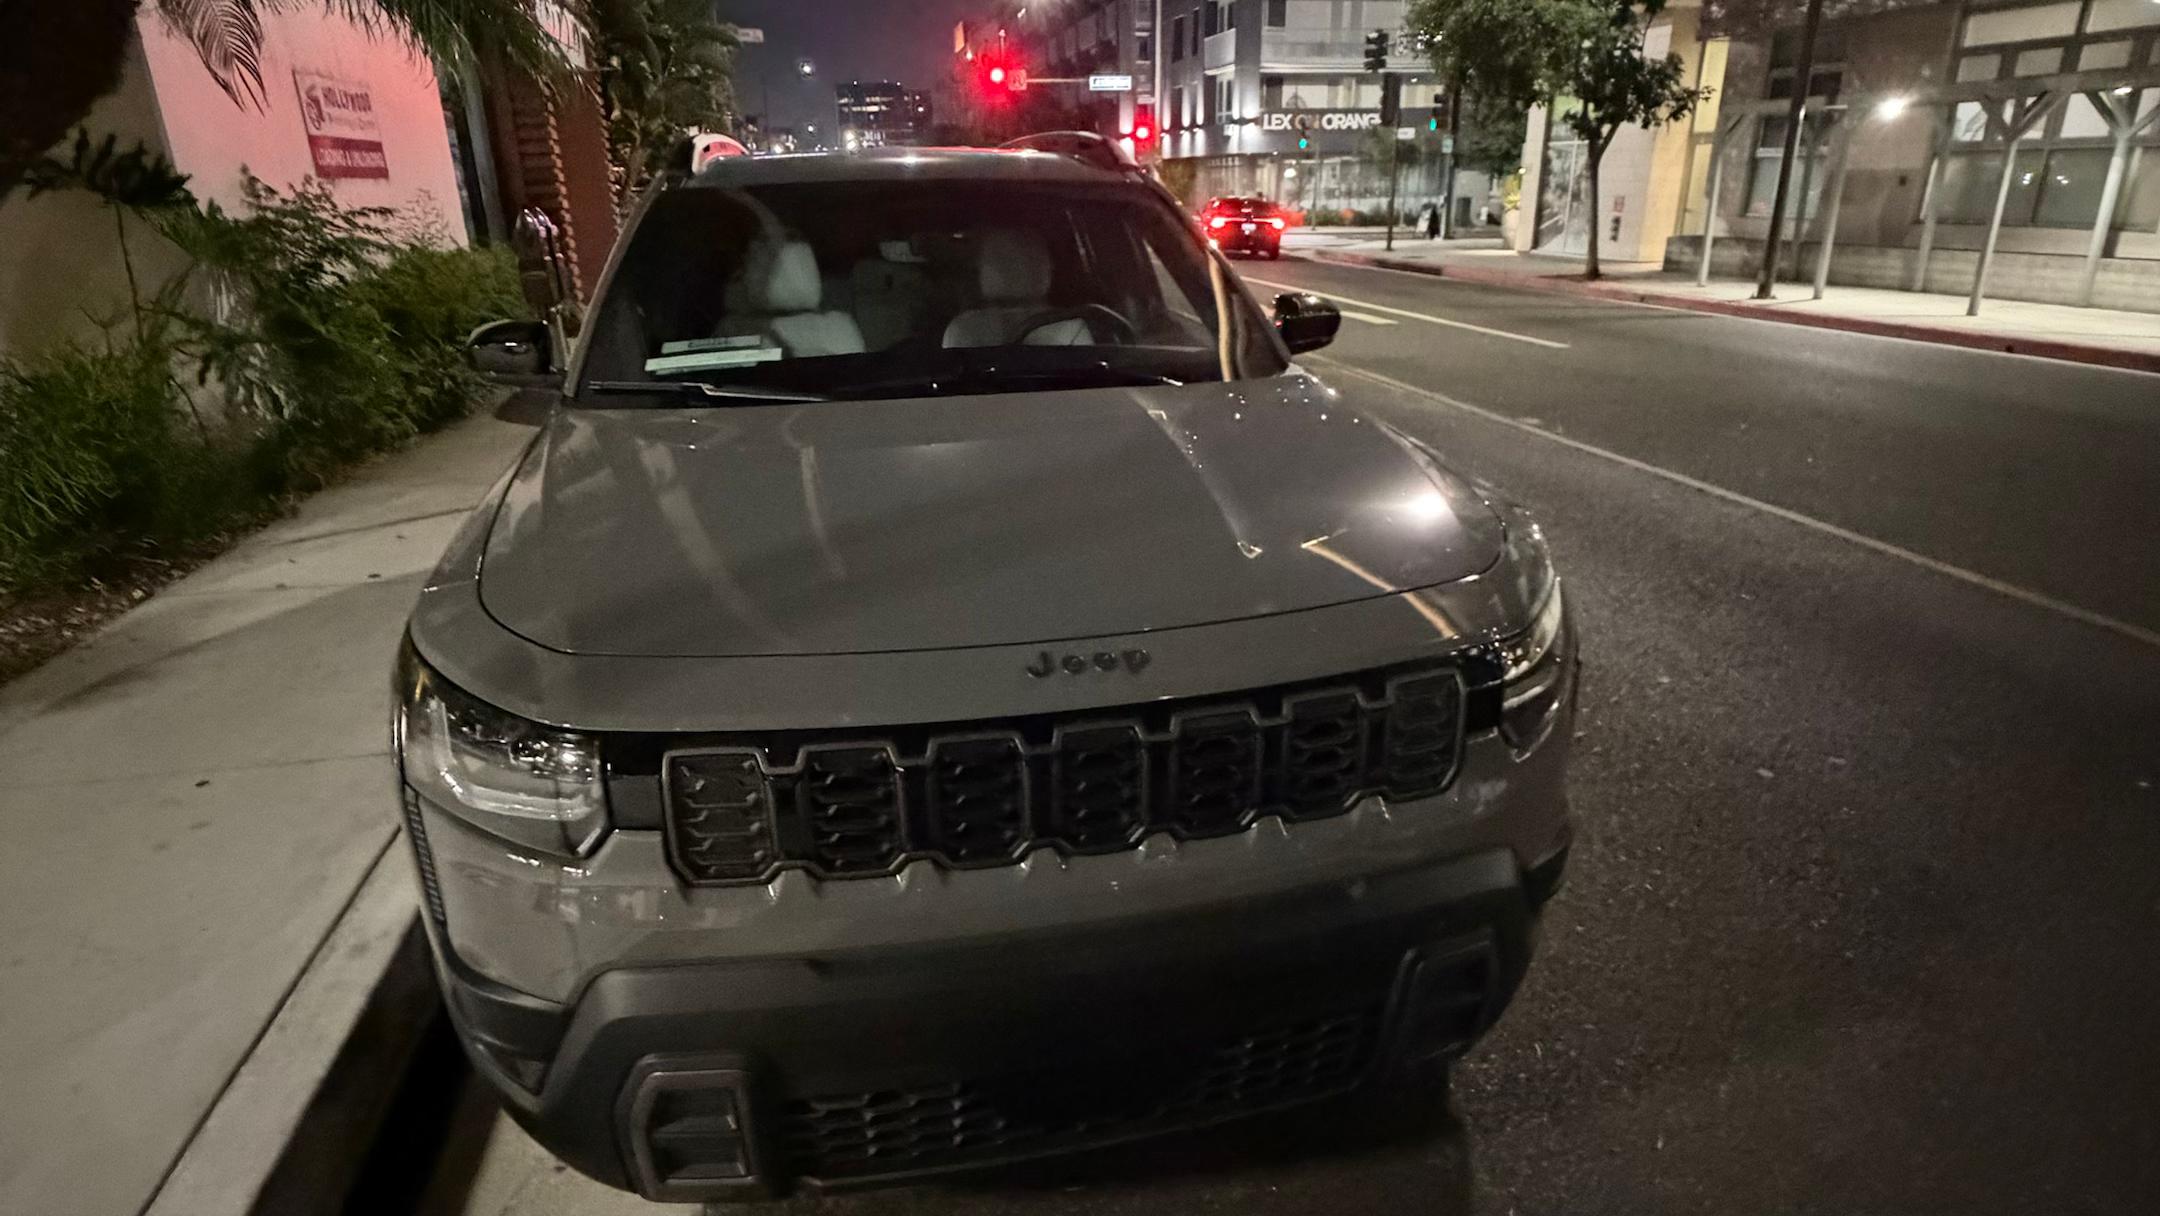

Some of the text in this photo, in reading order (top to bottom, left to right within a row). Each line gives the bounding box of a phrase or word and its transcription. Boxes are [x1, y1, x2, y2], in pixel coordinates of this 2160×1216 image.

[321, 87, 371, 112] HOLLYWOOD
[1263, 113, 1293, 130] LEX
[1026, 649, 1152, 679] Jeep
